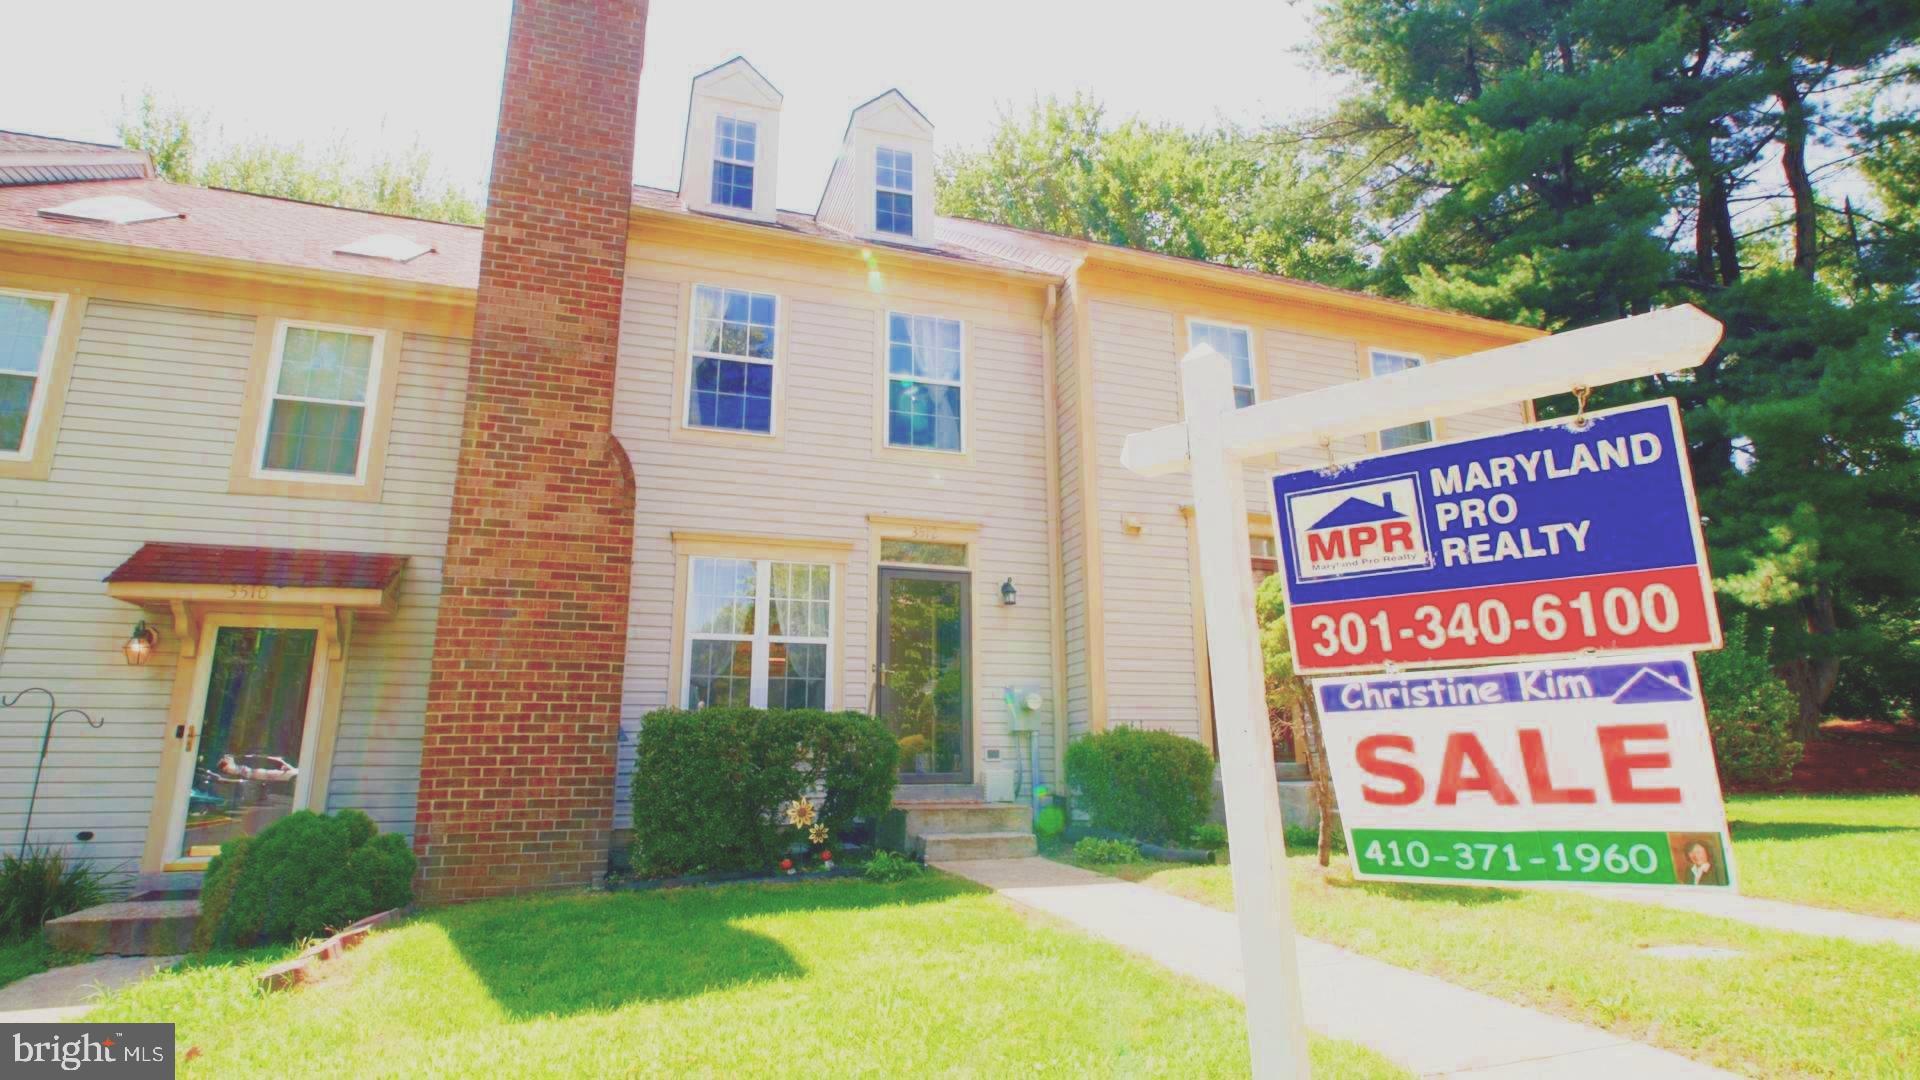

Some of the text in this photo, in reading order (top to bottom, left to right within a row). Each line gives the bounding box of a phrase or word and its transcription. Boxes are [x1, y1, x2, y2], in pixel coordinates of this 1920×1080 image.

[1430, 431, 1663, 497] MARYLAND
[1436, 493, 1519, 532] PRO
[1307, 521, 1414, 562] MPR
[1312, 553, 1417, 571] Maryland Pro Realty
[1441, 520, 1591, 568] REALTY
[1310, 583, 1680, 658] 301-340-6100
[1340, 669, 1594, 711] Christine Kim
[1354, 723, 1682, 807] SALE
[1364, 839, 1659, 875] 410-371-1960
